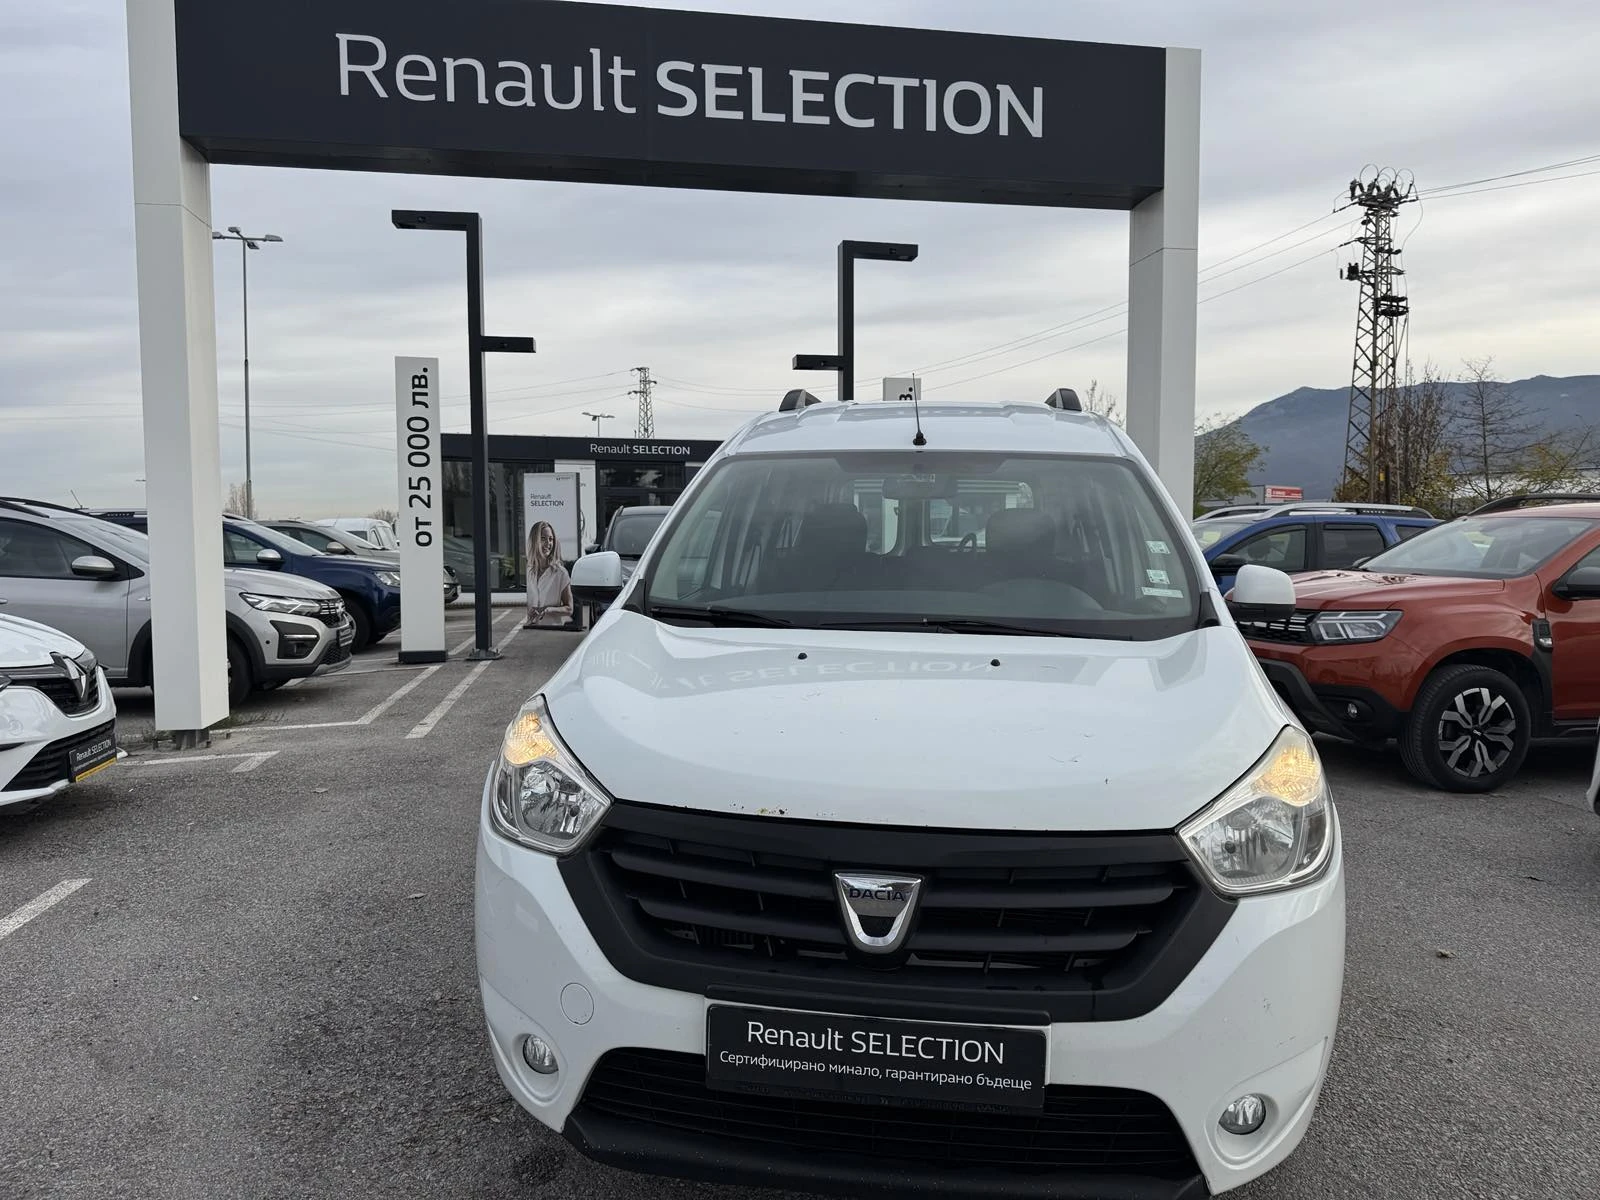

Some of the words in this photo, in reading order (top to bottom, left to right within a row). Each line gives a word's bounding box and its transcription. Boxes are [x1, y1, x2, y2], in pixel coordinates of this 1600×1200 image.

[336, 33, 637, 114] Renault
[656, 60, 1043, 138] SELECTION
[411, 367, 429, 409] лв.
[406, 416, 431, 468] 000
[590, 443, 631, 454] Renault
[633, 445, 691, 455] SELECTION
[408, 476, 432, 509] 25
[415, 516, 433, 547] от
[91, 739, 112, 755] SELECTION
[849, 888, 904, 901] DACIA
[747, 1021, 843, 1052] Renault
[851, 1031, 1004, 1064] SELECTION
[720, 1050, 826, 1072] Сертифицирано
[829, 1063, 882, 1079] минало,
[885, 1068, 973, 1085] гарантирано
[976, 1073, 1032, 1090] бъдеще
